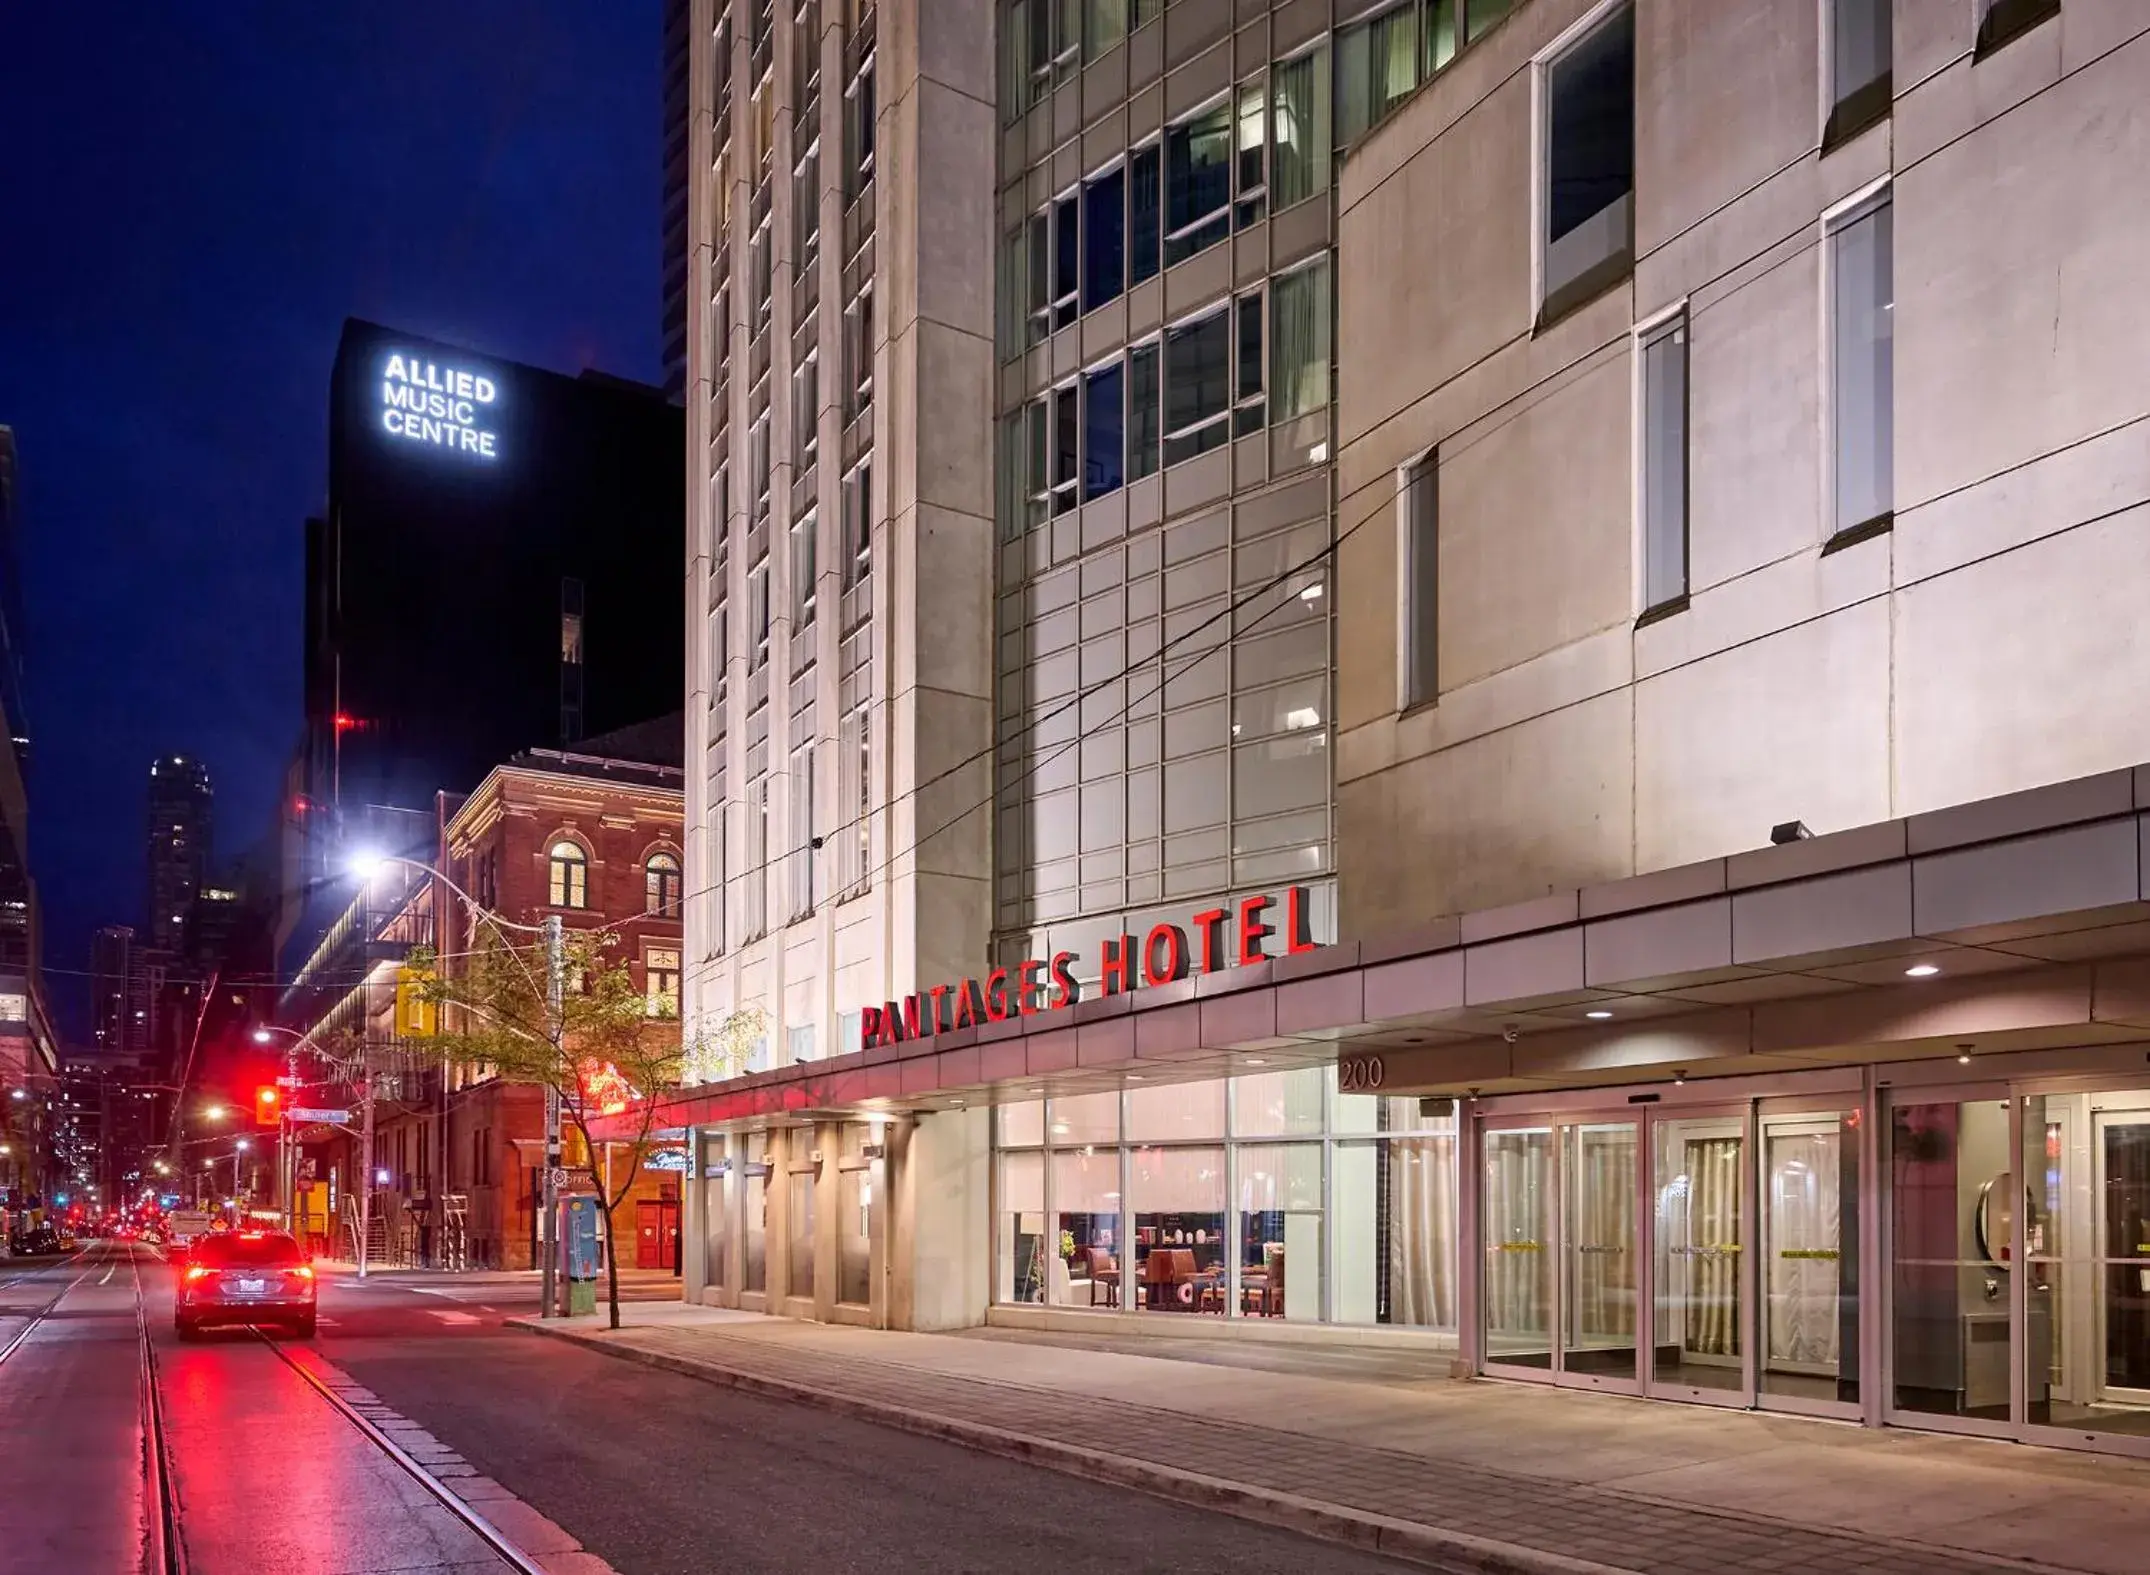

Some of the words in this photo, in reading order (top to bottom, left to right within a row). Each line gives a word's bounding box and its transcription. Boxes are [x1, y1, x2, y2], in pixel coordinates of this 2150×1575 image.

[384, 354, 496, 403] ALLIED
[384, 382, 474, 425] MUSIC
[384, 408, 496, 457] CENTRE
[861, 951, 1080, 1049] PANTAGES
[1101, 886, 1317, 998] HOTEL
[1341, 1055, 1384, 1093] 200
